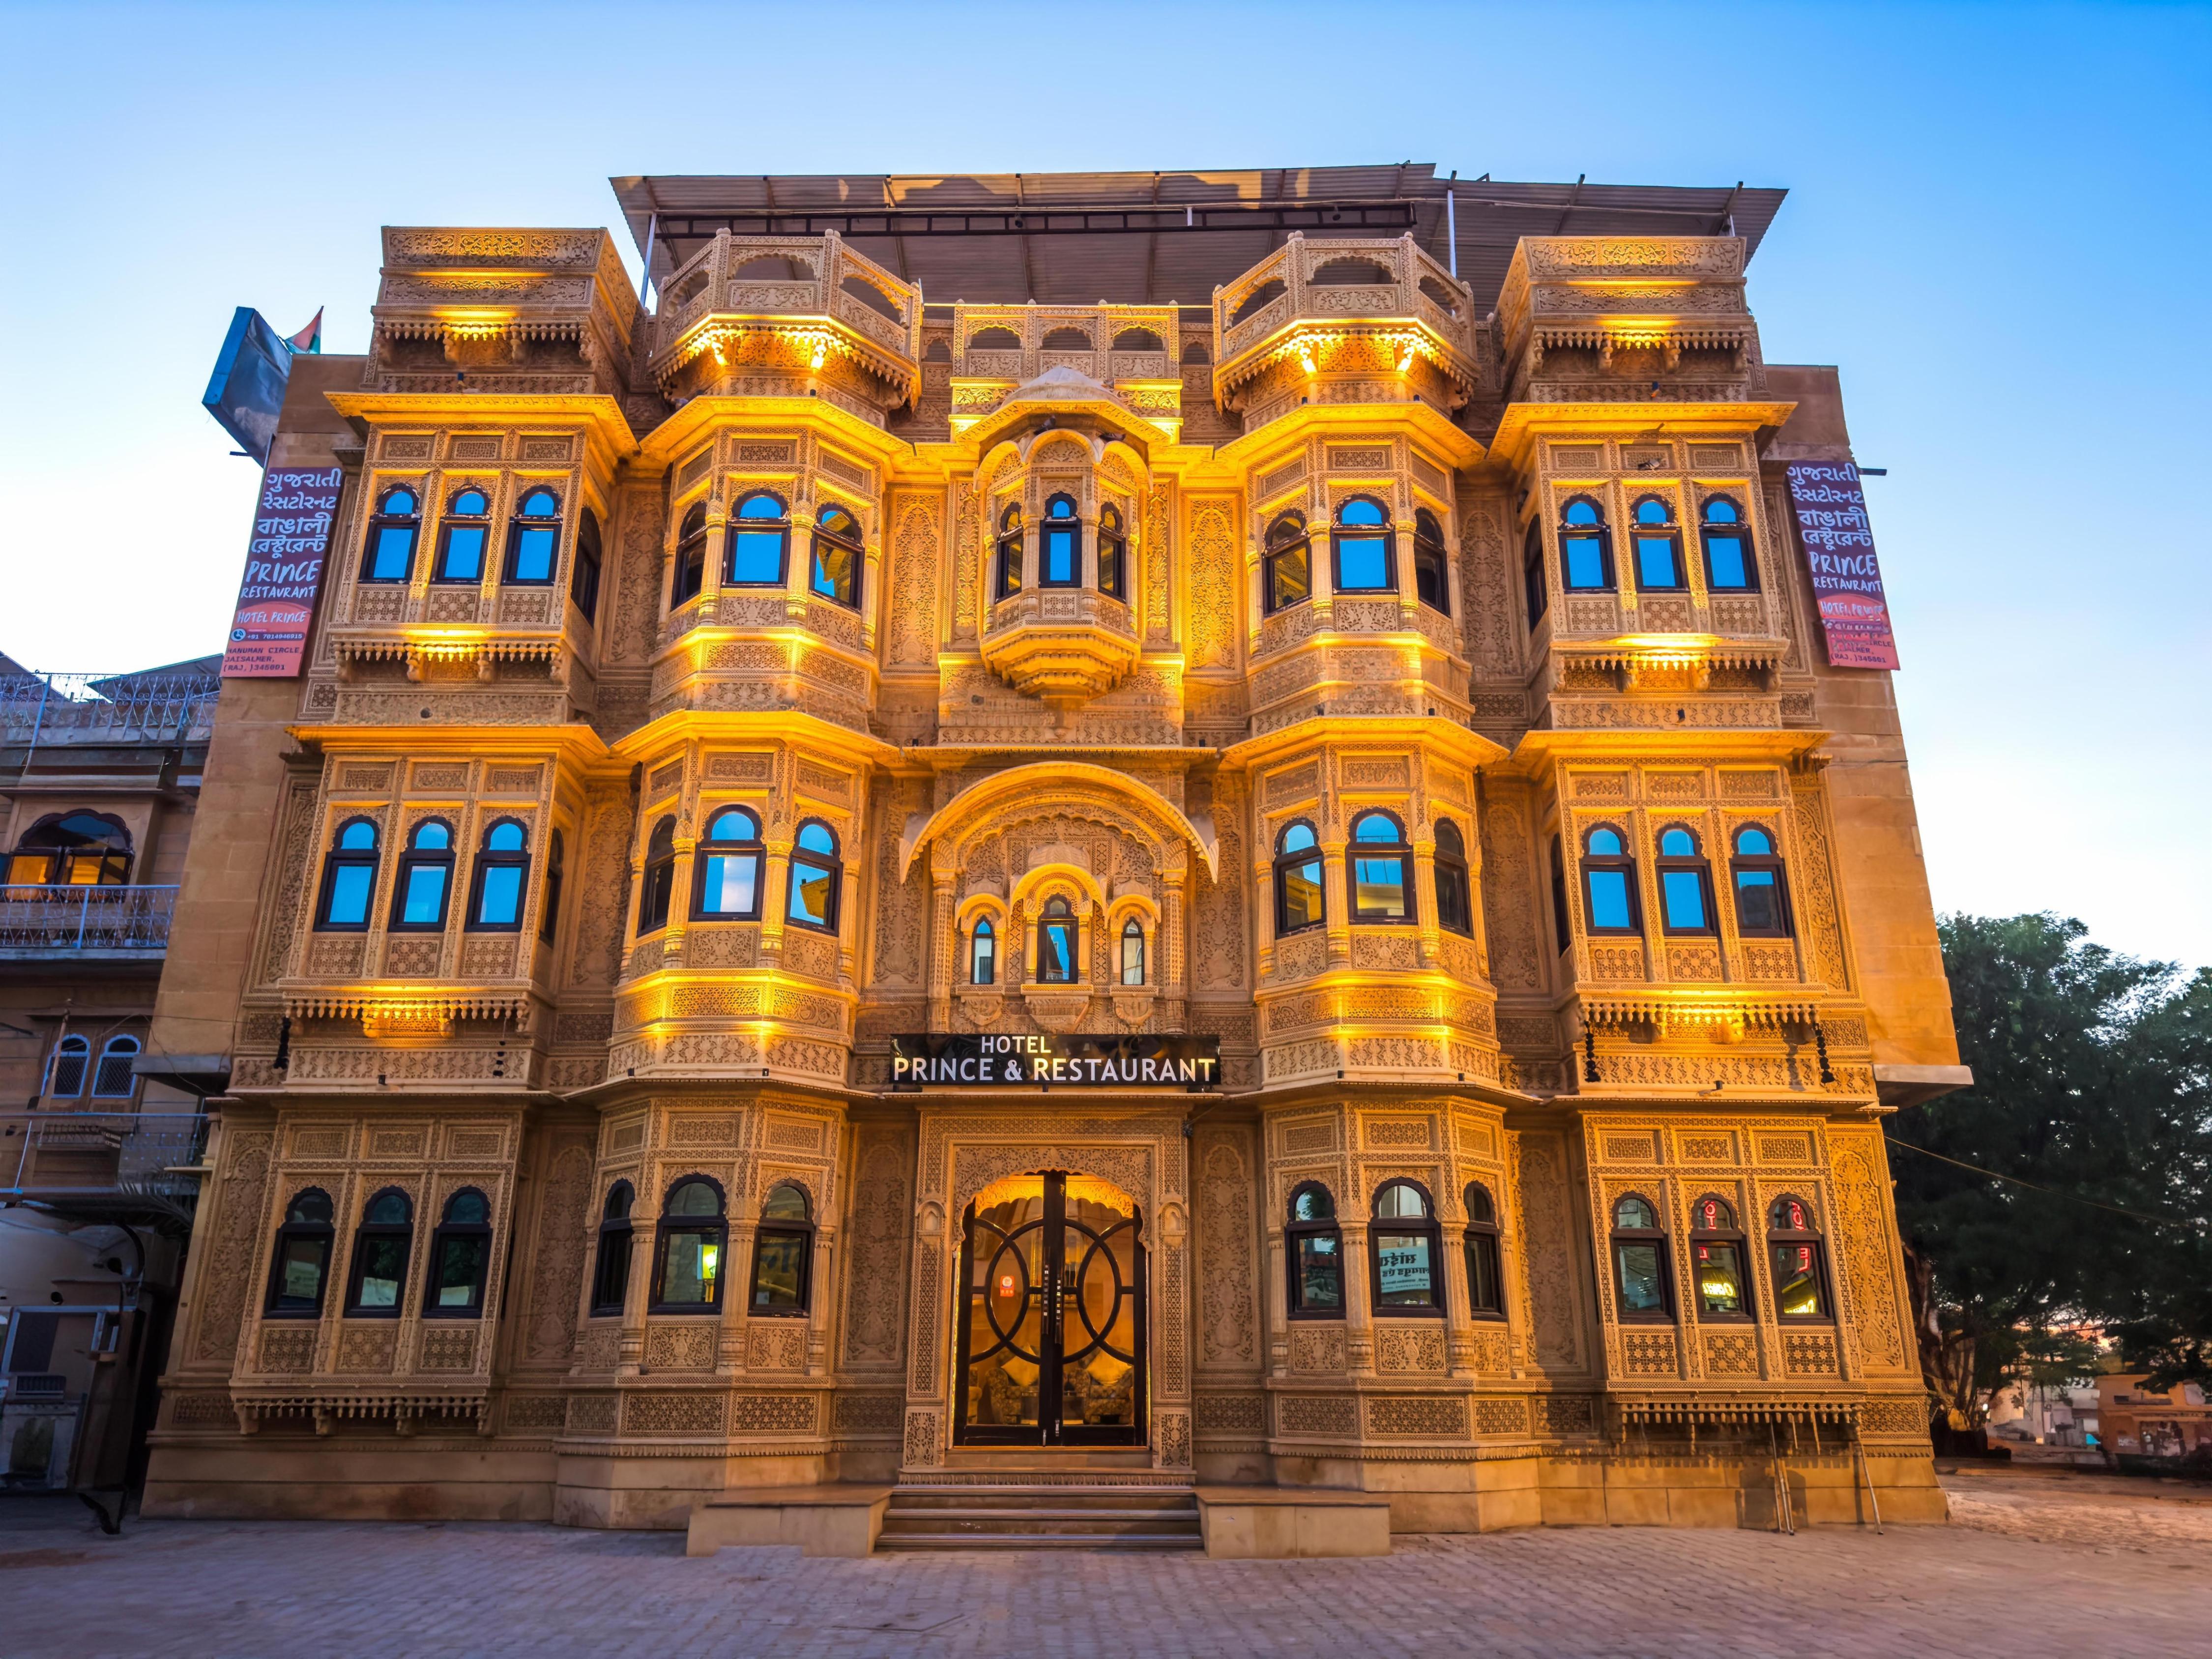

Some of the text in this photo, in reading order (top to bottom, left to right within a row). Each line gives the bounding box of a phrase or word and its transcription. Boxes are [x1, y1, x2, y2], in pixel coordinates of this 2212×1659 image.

[267, 467, 342, 492] ગુજરાતી
[1786, 462, 1860, 485] ગુજરાતી
[258, 512, 333, 534] বাঙালী
[1796, 506, 1867, 528] বাঙালী
[246, 559, 322, 583] PRINCE
[1809, 551, 1876, 576] PRINCE
[240, 585, 317, 598] RESTAURANT
[1813, 576, 1882, 592] RESTAURANT
[236, 611, 308, 624] HOTEL PRINCE
[982, 1036, 1051, 1053] HOTEL
[894, 1058, 1216, 1081] PRINCE & RESTAURANT
